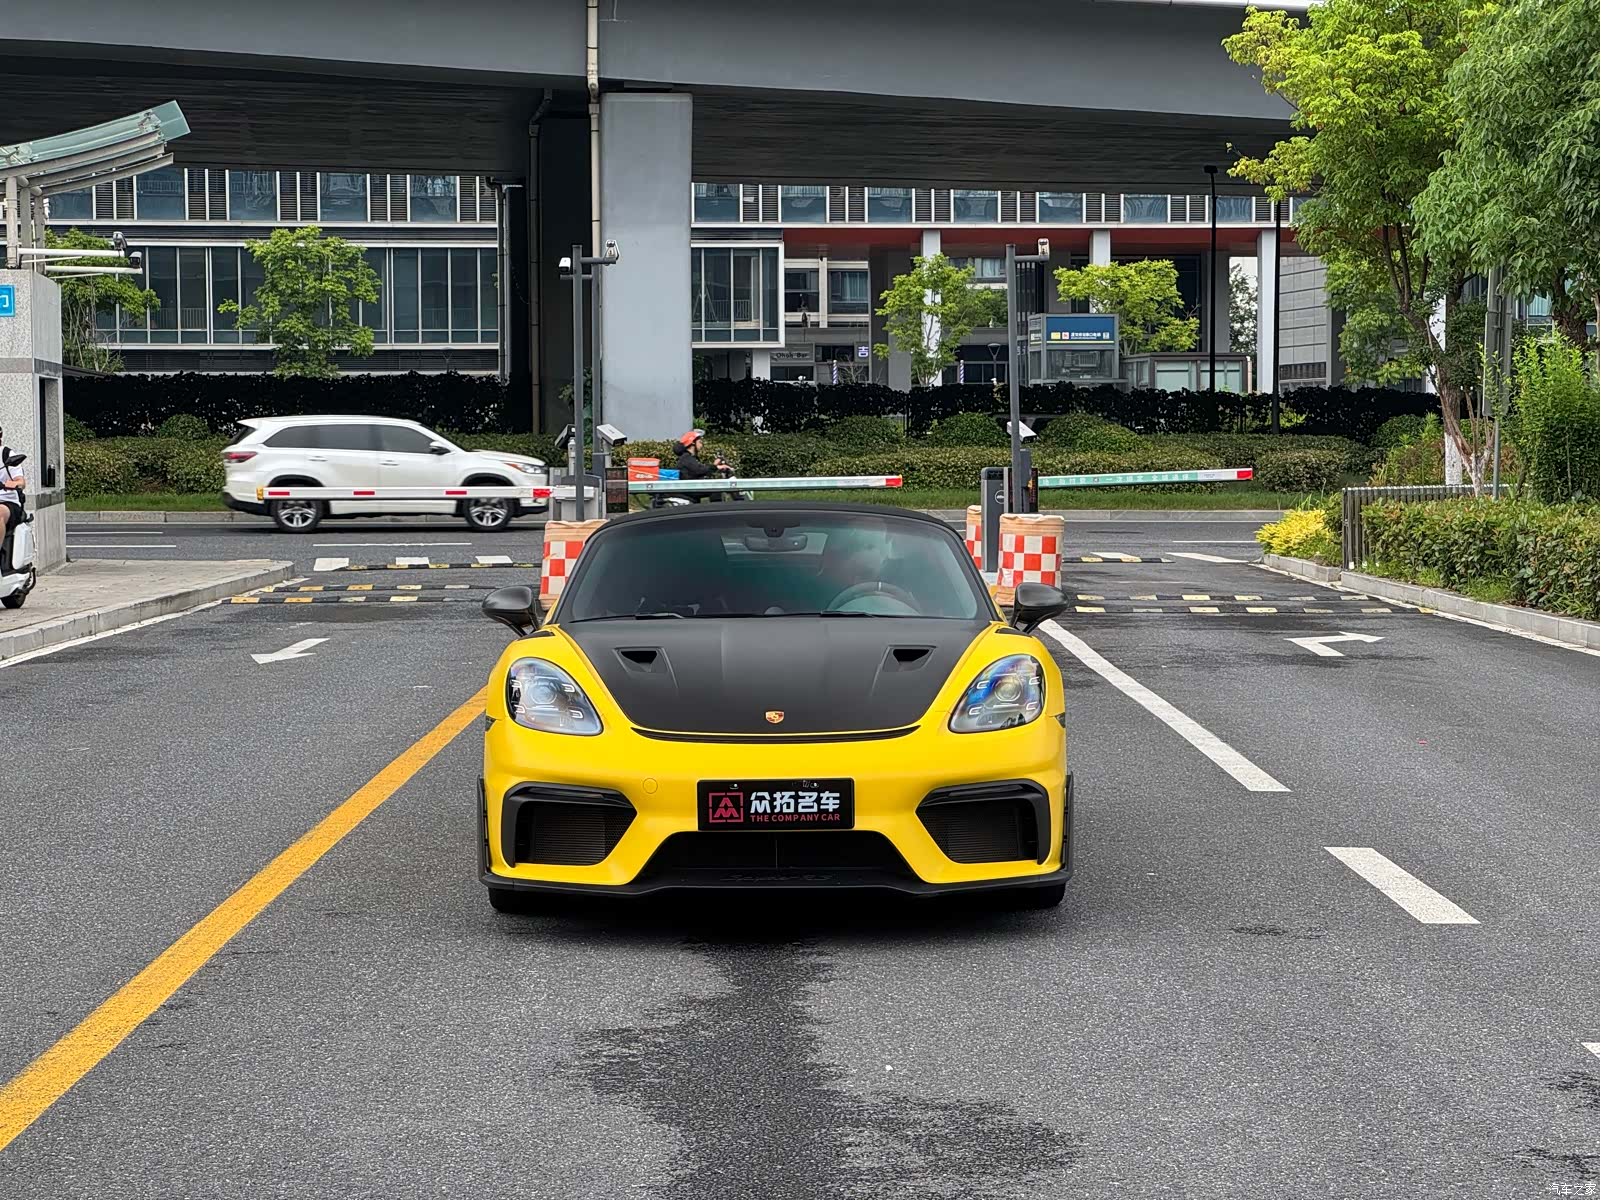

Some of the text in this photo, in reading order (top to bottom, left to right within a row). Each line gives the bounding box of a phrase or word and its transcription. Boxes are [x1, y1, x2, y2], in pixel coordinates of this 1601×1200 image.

[750, 791, 841, 813] 众拓名车
[771, 814, 819, 822] COMPANY
[821, 813, 841, 821] CAR
